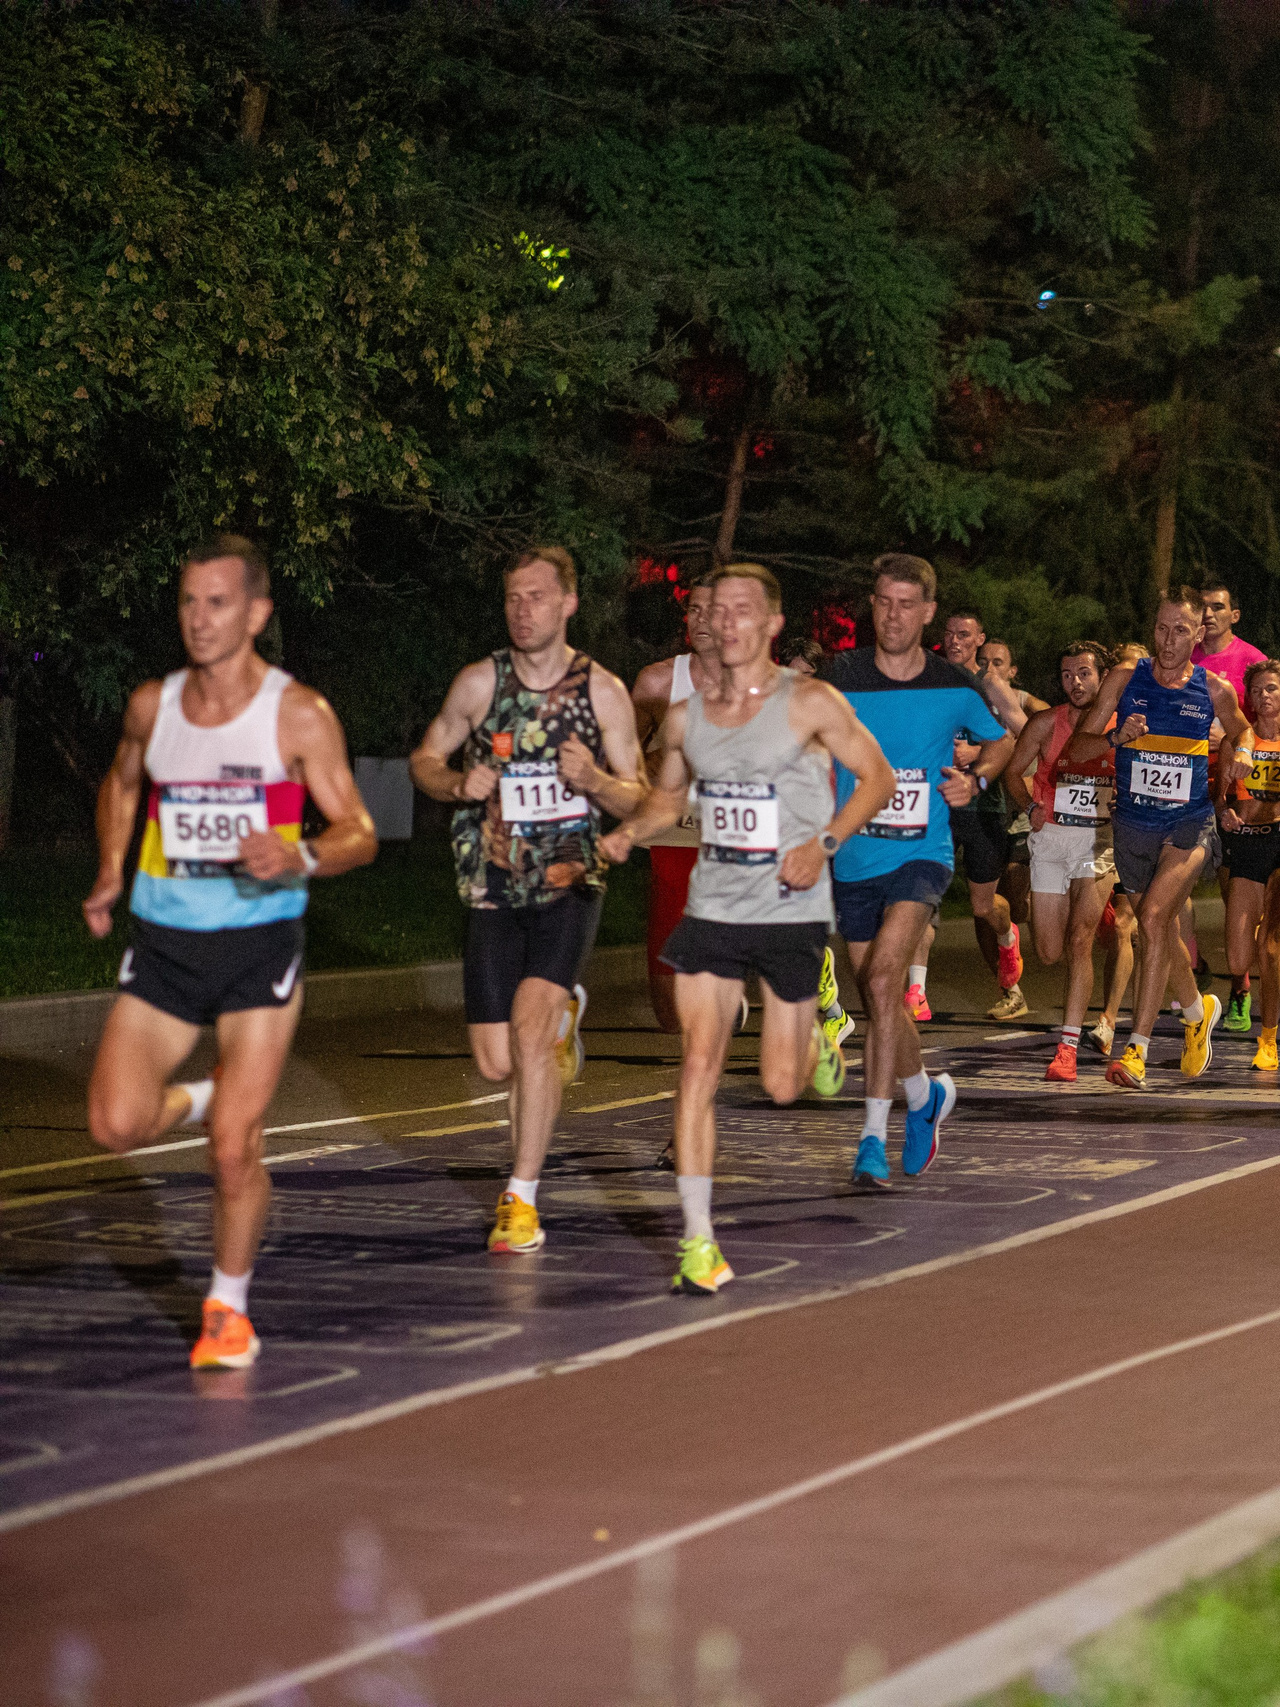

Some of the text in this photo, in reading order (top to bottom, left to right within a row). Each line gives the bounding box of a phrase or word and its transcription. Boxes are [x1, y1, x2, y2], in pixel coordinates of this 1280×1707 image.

[1179, 709, 1208, 720] ORIENT
[1181, 703, 1201, 712] MSU
[1139, 750, 1189, 766] НОЧНОЙ
[1140, 768, 1183, 789] 1241
[514, 783, 574, 807] 1116
[1069, 788, 1099, 807] 754
[1147, 786, 1172, 795] МАКСИМ
[884, 790, 920, 811] 87
[174, 812, 252, 842] 5680
[713, 806, 757, 832] 810
[1241, 825, 1272, 836] PRO
